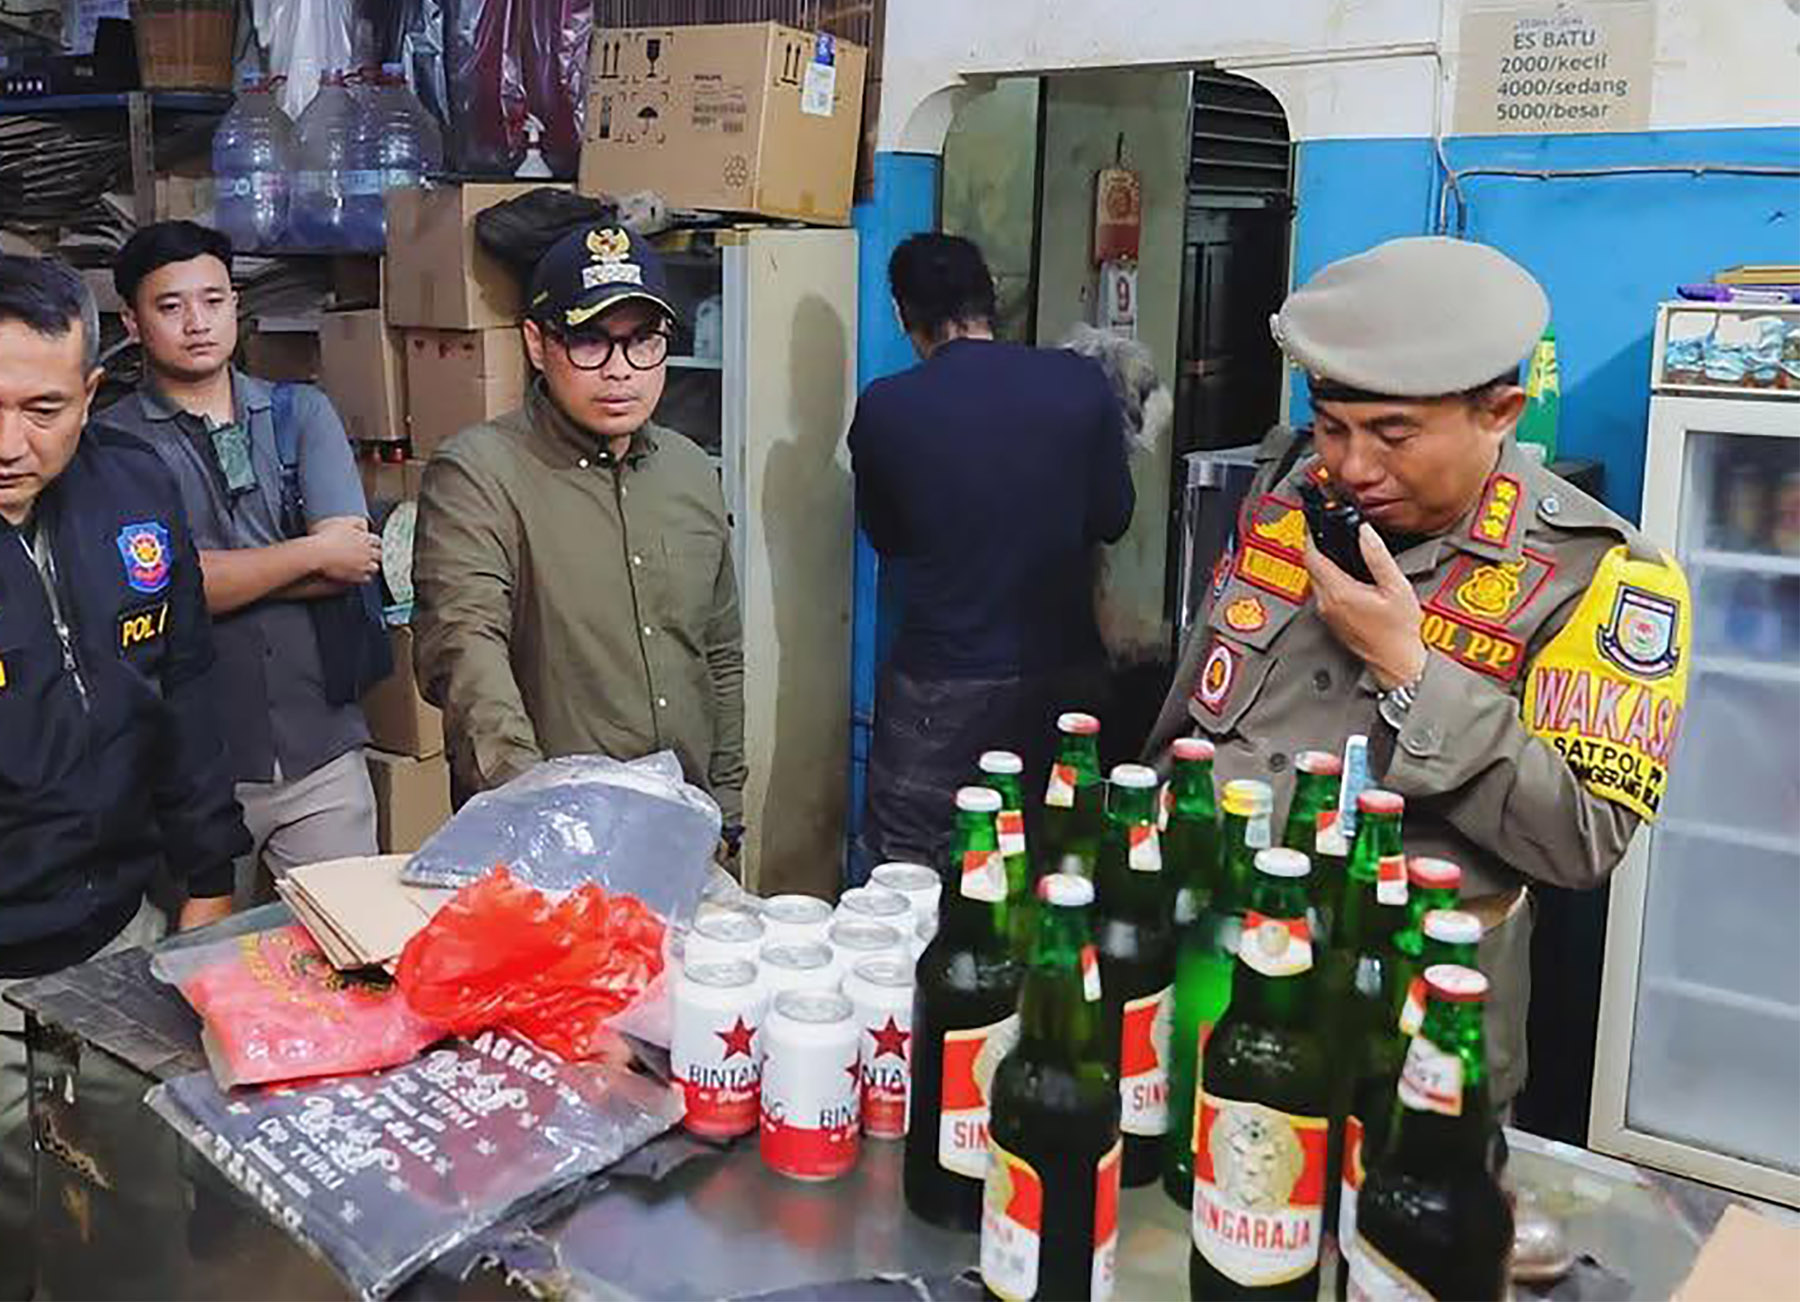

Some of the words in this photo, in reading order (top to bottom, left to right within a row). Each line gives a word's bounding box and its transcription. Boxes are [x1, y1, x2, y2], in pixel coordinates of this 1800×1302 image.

[1513, 32, 1536, 50] ES
[1542, 29, 1596, 48] BATU
[1501, 53, 1607, 74] 2000/kecil
[1497, 77, 1628, 97] 4000/sedang
[1497, 102, 1611, 120] 5000/besar
[1463, 631, 1516, 669] PP
[1533, 666, 1684, 758] WAKAS
[688, 1063, 762, 1093] BINTAN
[1133, 1083, 1167, 1111] SIN
[953, 1120, 988, 1149] SIN
